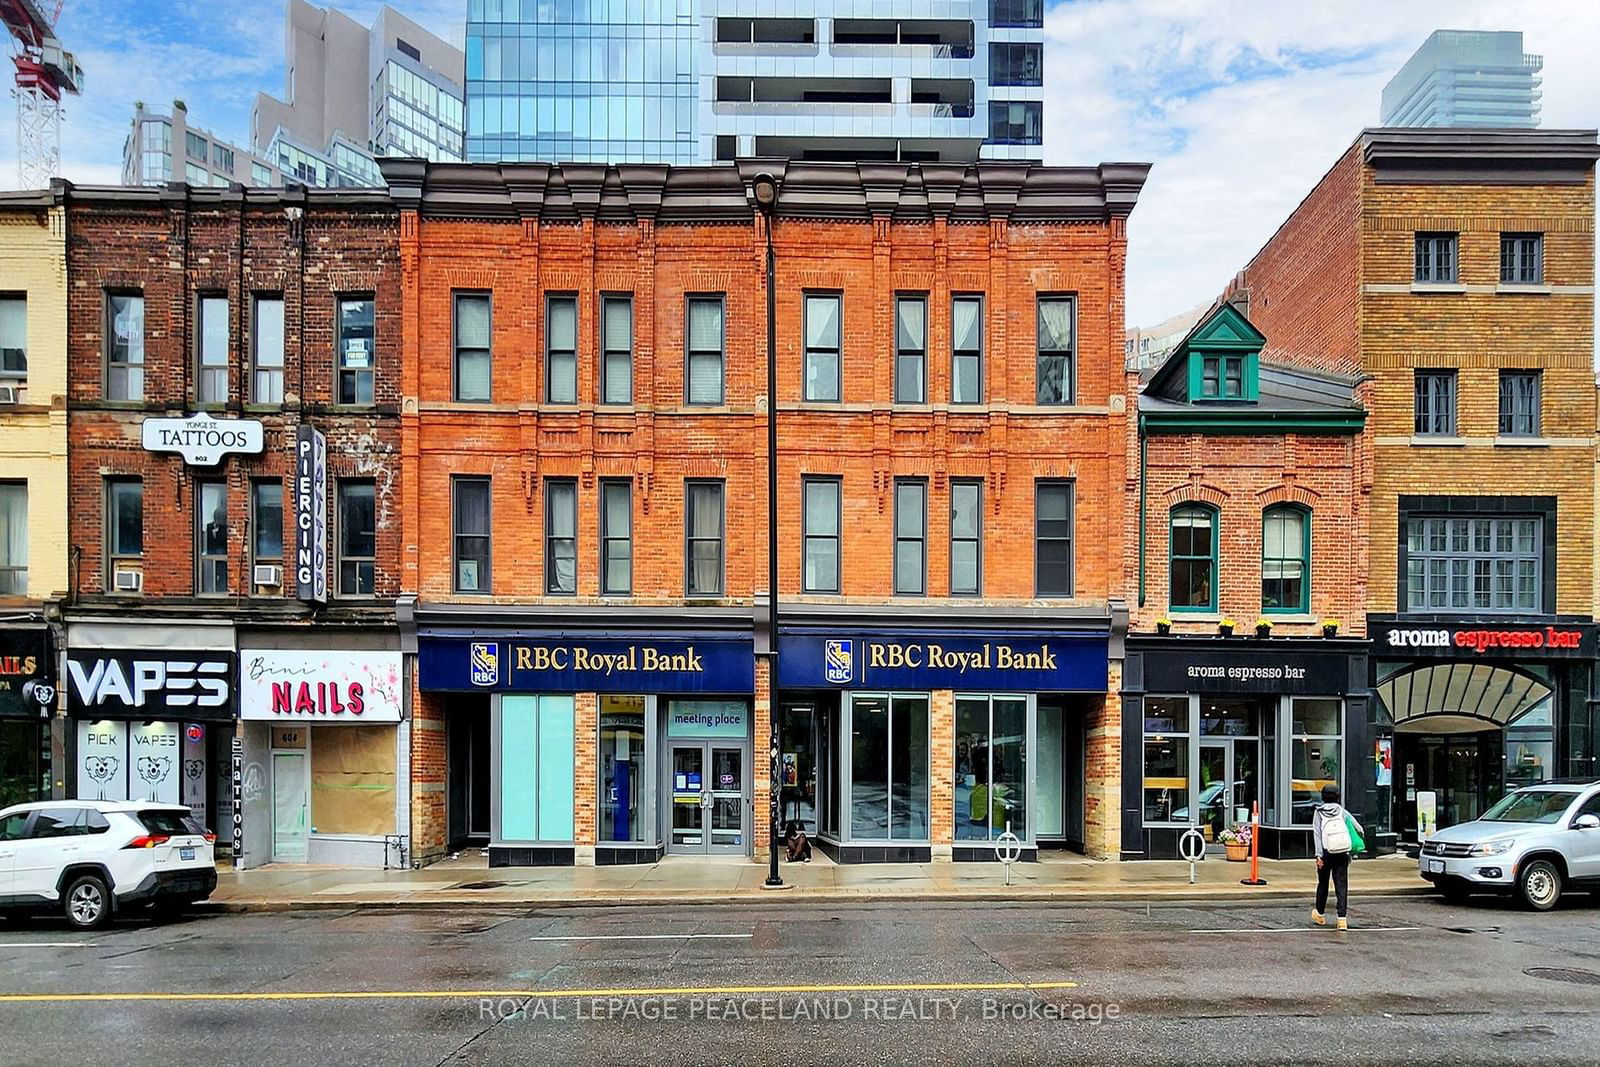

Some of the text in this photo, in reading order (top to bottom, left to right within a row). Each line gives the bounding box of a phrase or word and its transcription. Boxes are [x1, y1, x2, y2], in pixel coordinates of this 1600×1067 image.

[186, 421, 208, 429] YONGE
[159, 430, 247, 447] TATTOOS
[298, 440, 312, 584] PIERCING
[1387, 627, 1582, 653] aroma espresso bar
[516, 646, 703, 676] RBC Royal Bank
[869, 643, 1057, 674] RBC Royal Bank
[250, 656, 316, 680] Bini
[829, 669, 850, 680] RBC
[1187, 665, 1306, 681] aroma espresso bar
[67, 658, 228, 707] VAPES
[474, 672, 496, 682] RBC
[272, 681, 365, 714] NAILS
[675, 713, 741, 726] meeting place
[88, 734, 117, 745] PICK
[134, 734, 176, 746] VAPES
